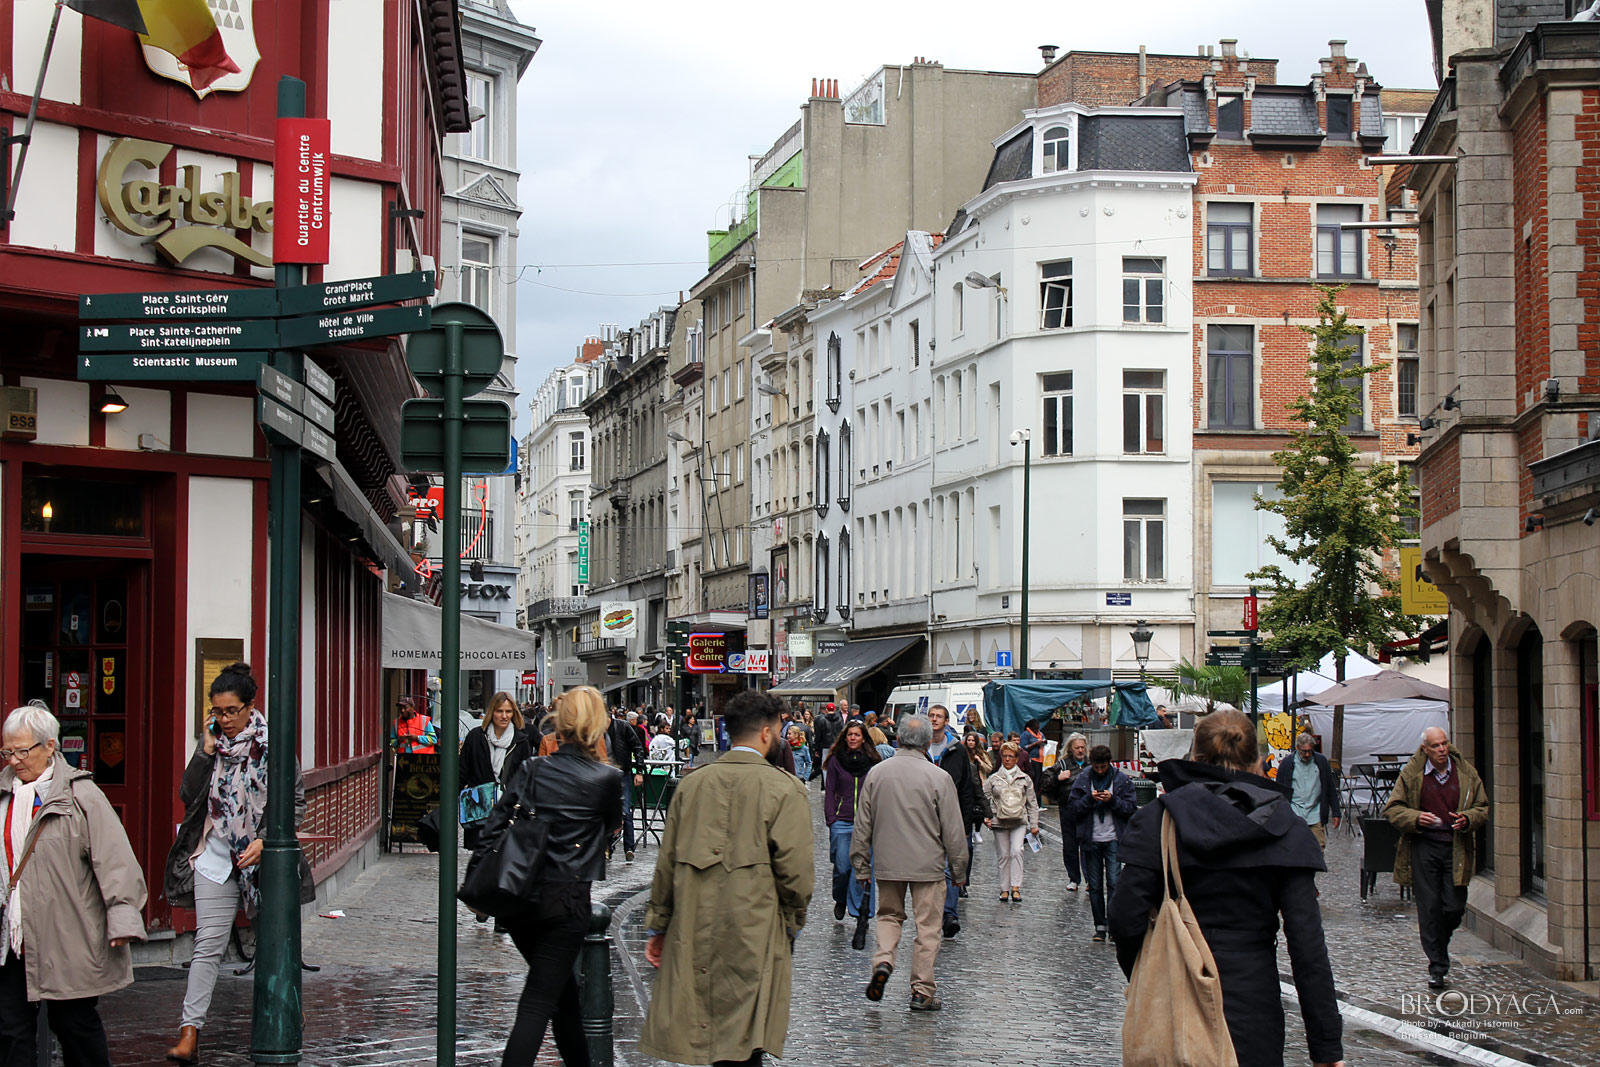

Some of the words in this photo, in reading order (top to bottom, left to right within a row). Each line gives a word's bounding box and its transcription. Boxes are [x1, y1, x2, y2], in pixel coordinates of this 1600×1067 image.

[298, 134, 310, 173] Centre
[98, 137, 274, 236] Carlsbe
[298, 179, 310, 194] du
[311, 152, 326, 229] Centrumwijk
[297, 199, 309, 246] Quartier
[142, 295, 170, 305] Place
[174, 294, 229, 304] Saint-Géry
[323, 295, 347, 306] Grote
[349, 291, 374, 303] Markt
[144, 305, 227, 315] Sint-Goriksplein
[319, 316, 340, 329] Hôtel
[343, 317, 353, 325] de
[356, 314, 374, 324] Ville
[129, 327, 155, 337] Place
[159, 325, 242, 336] Sainte-Catherine
[328, 325, 364, 339] Stadhuis
[140, 336, 231, 348] Sint-Katelijneplein
[132, 357, 191, 367] Scientastic
[195, 357, 238, 367] Museum
[579, 525, 588, 577] HOTEL
[692, 639, 725, 647] Galerie
[391, 650, 443, 659] HOMEMAD
[693, 653, 724, 661] Centre
